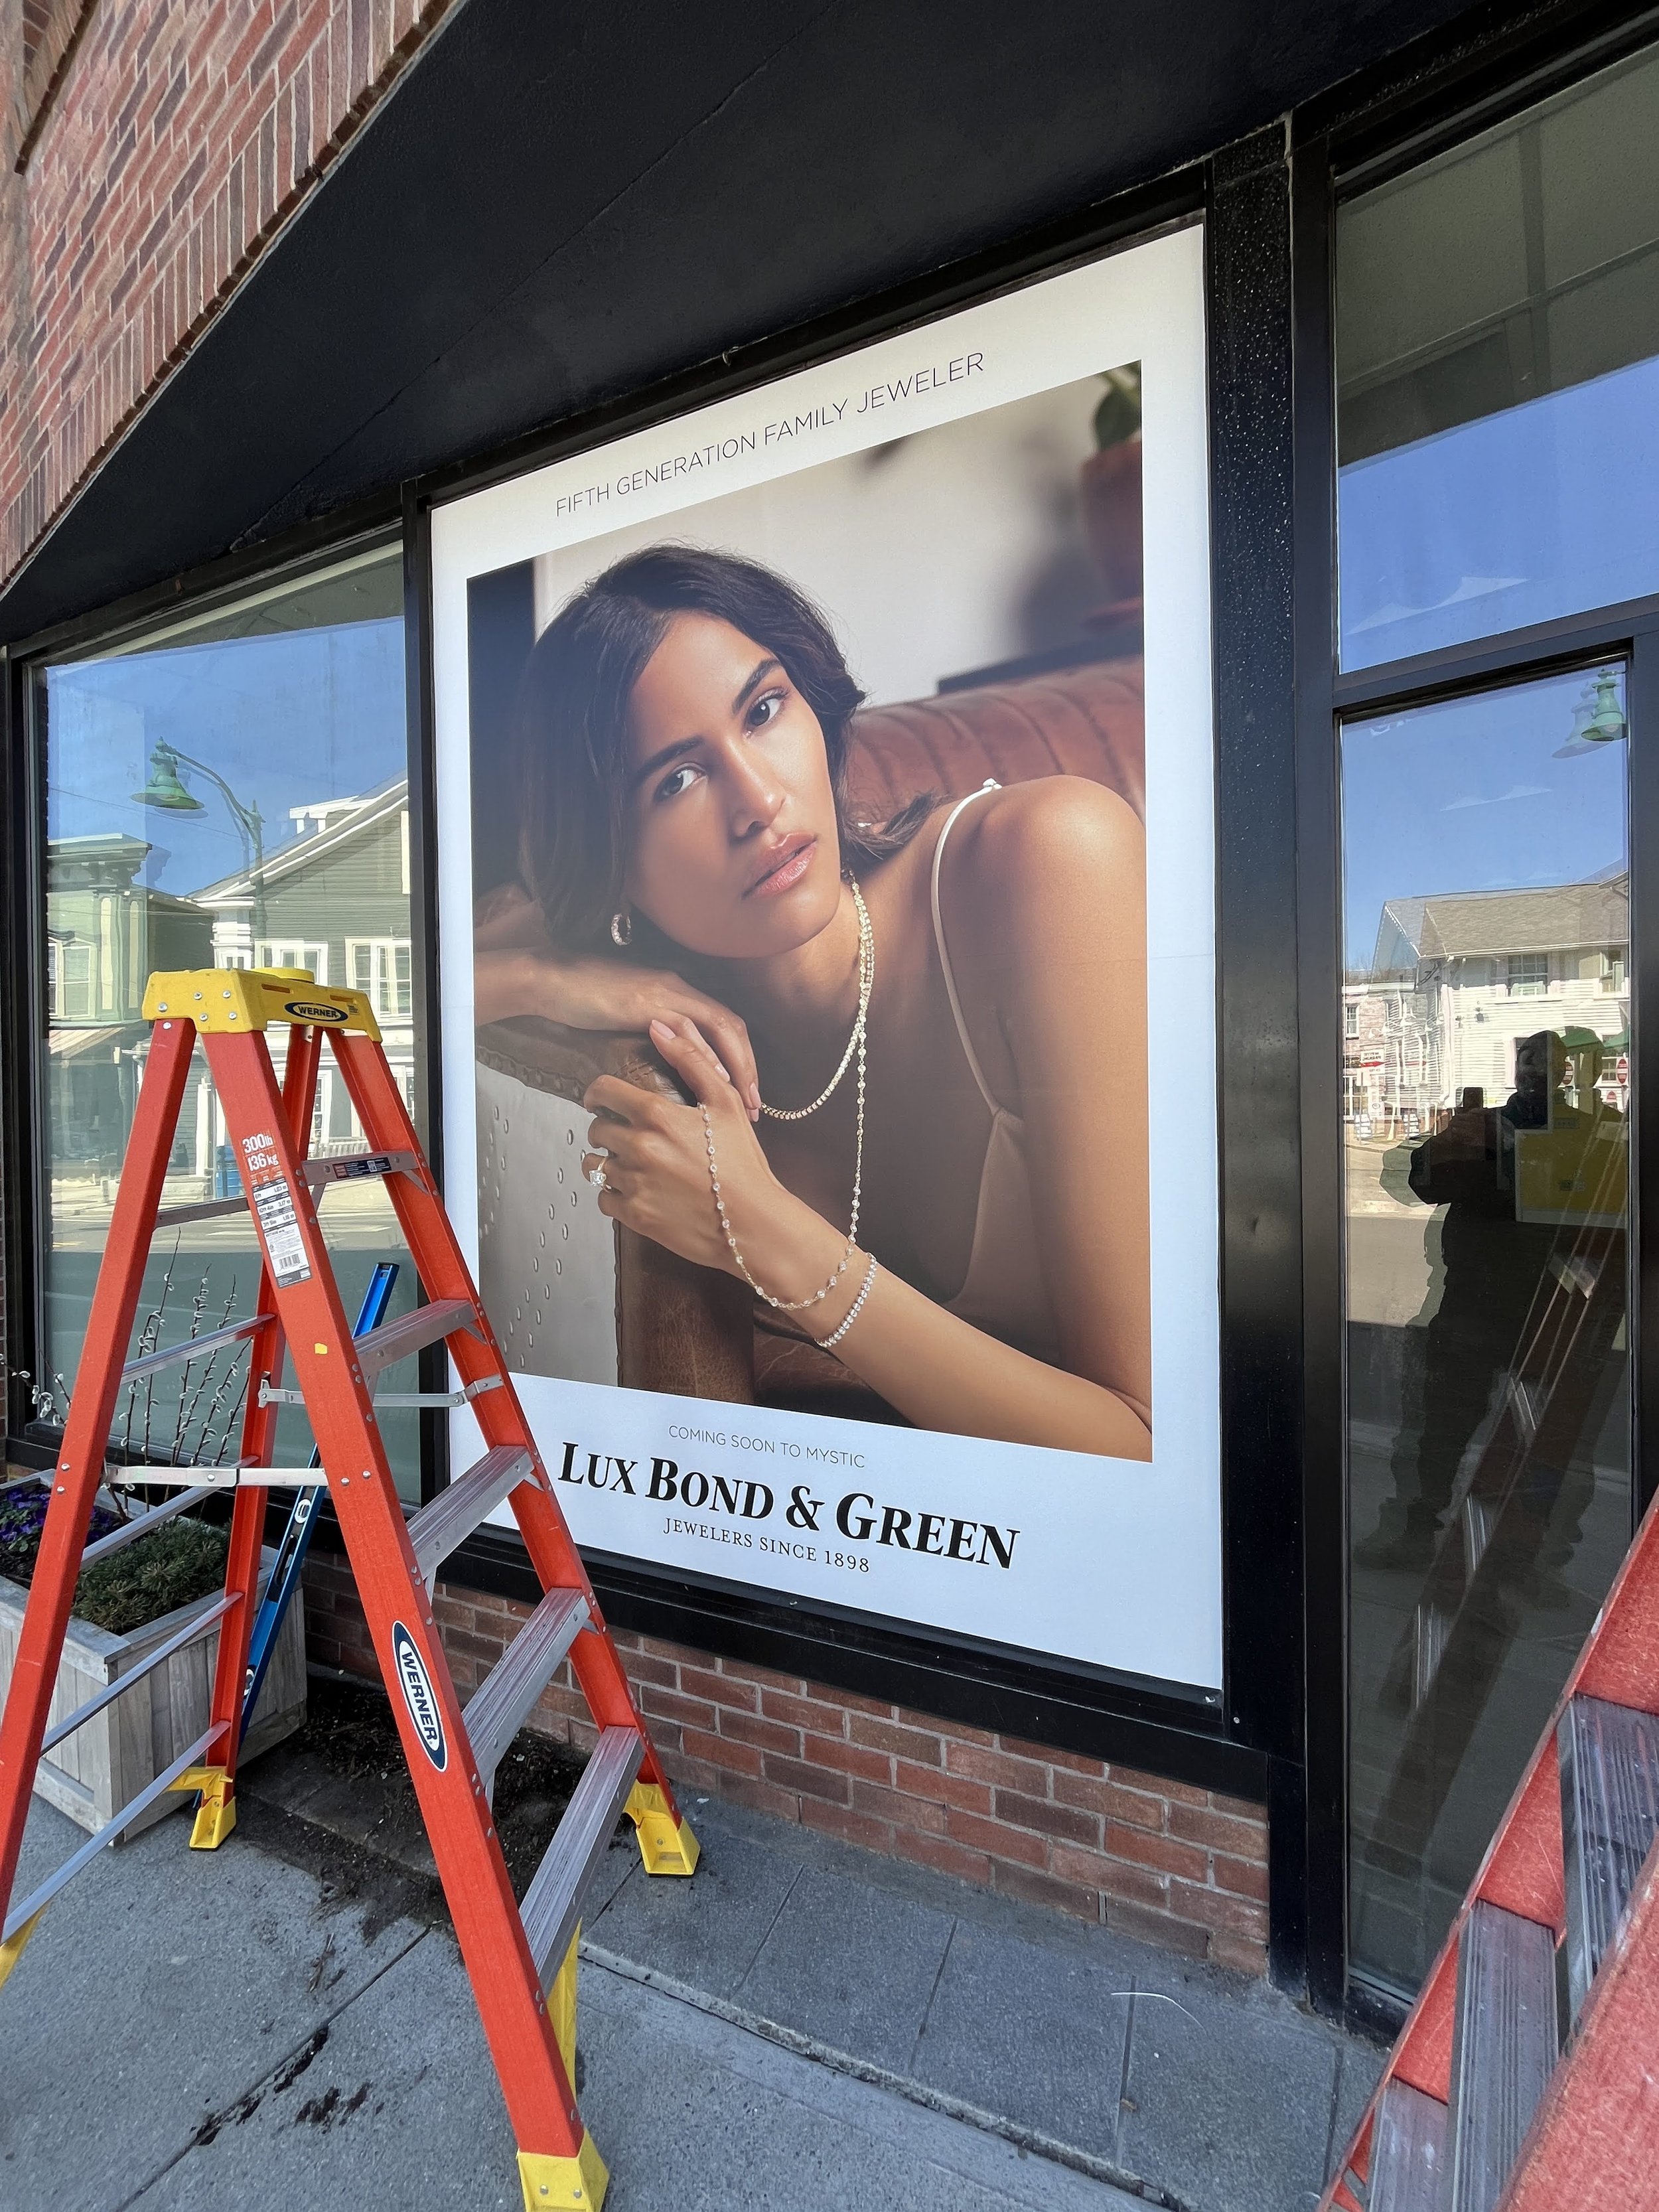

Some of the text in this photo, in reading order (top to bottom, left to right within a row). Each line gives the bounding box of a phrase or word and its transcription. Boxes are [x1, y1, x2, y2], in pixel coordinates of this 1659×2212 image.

[556, 352, 985, 518] FIFTH GENERATION FAMILY JEWELER
[297, 1005, 337, 1018] WERNER
[668, 1425, 865, 1468] COMING SOON TO MYSTIC
[558, 1441, 1021, 1569] LUX BOND & GREEN
[663, 1518, 869, 1572] JEWELERS SINCE 1898
[401, 1651, 438, 1741] WERNER
